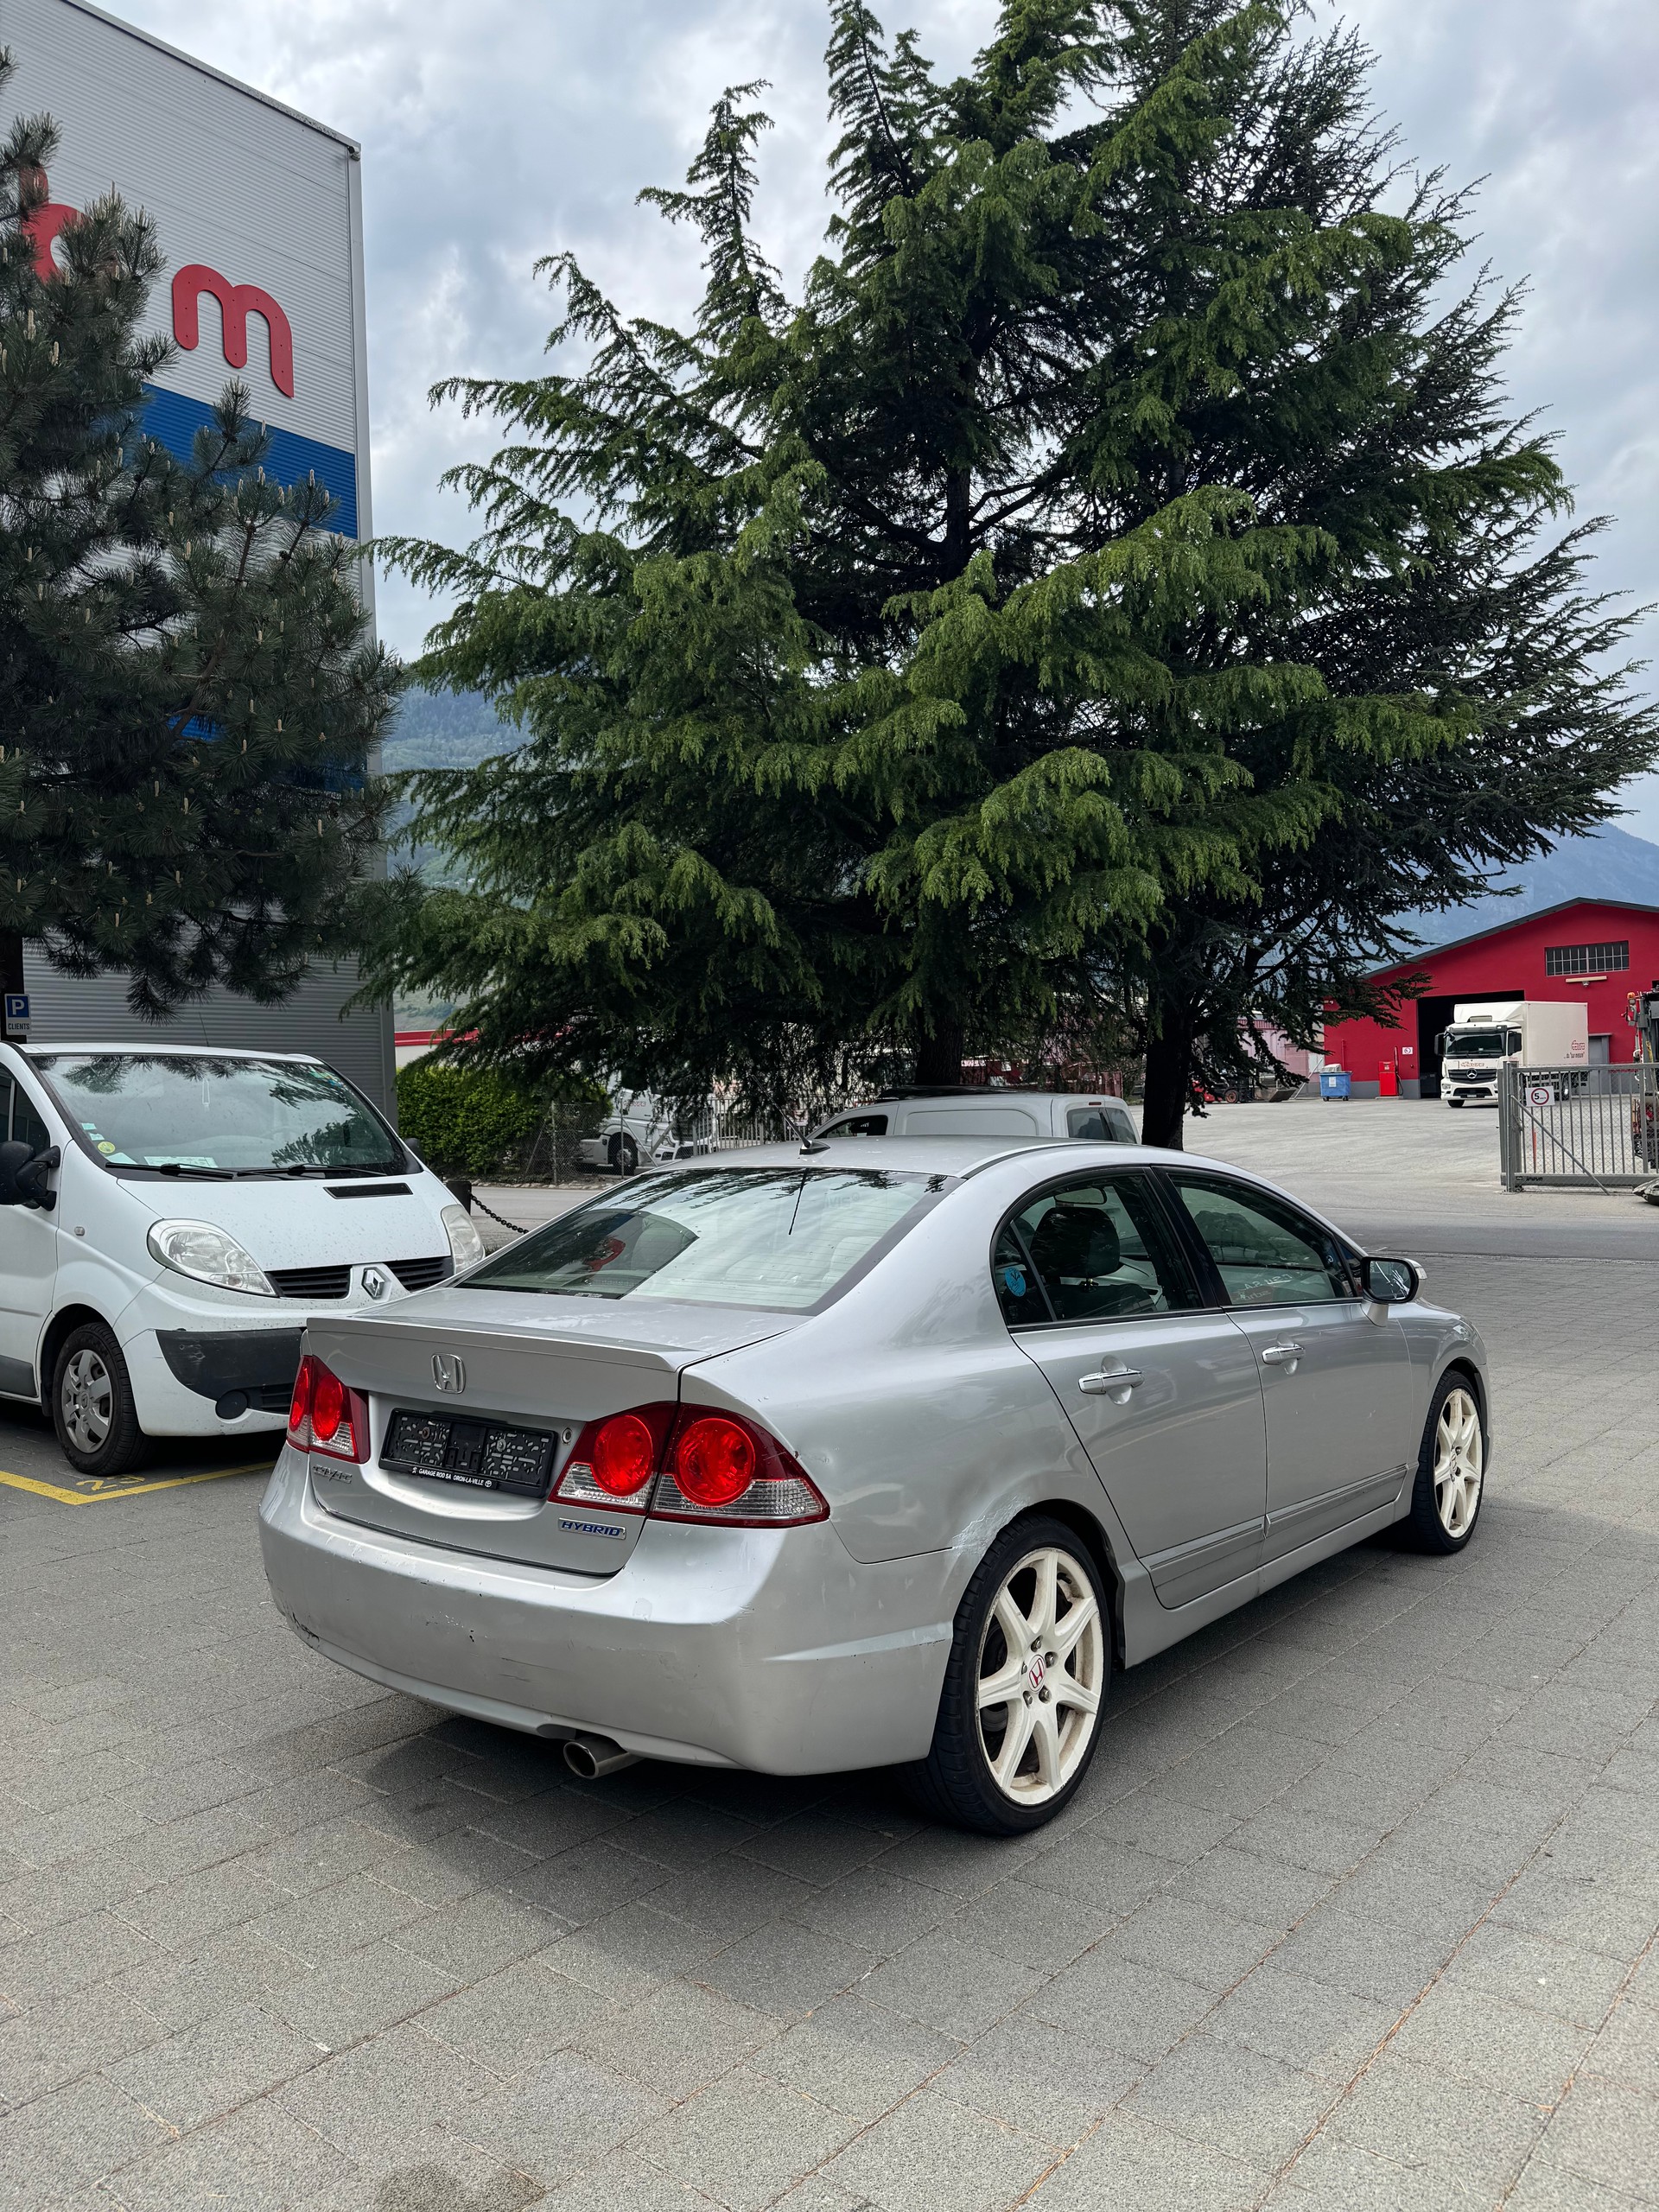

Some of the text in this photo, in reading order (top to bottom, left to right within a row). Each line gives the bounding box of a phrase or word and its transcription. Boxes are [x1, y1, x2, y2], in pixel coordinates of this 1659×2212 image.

[11, 999, 25, 1015] P
[418, 1468, 435, 1477] GARAGE
[453, 1474, 484, 1486] ORON-LA-VILLE
[561, 1521, 621, 1536] HYBRID
